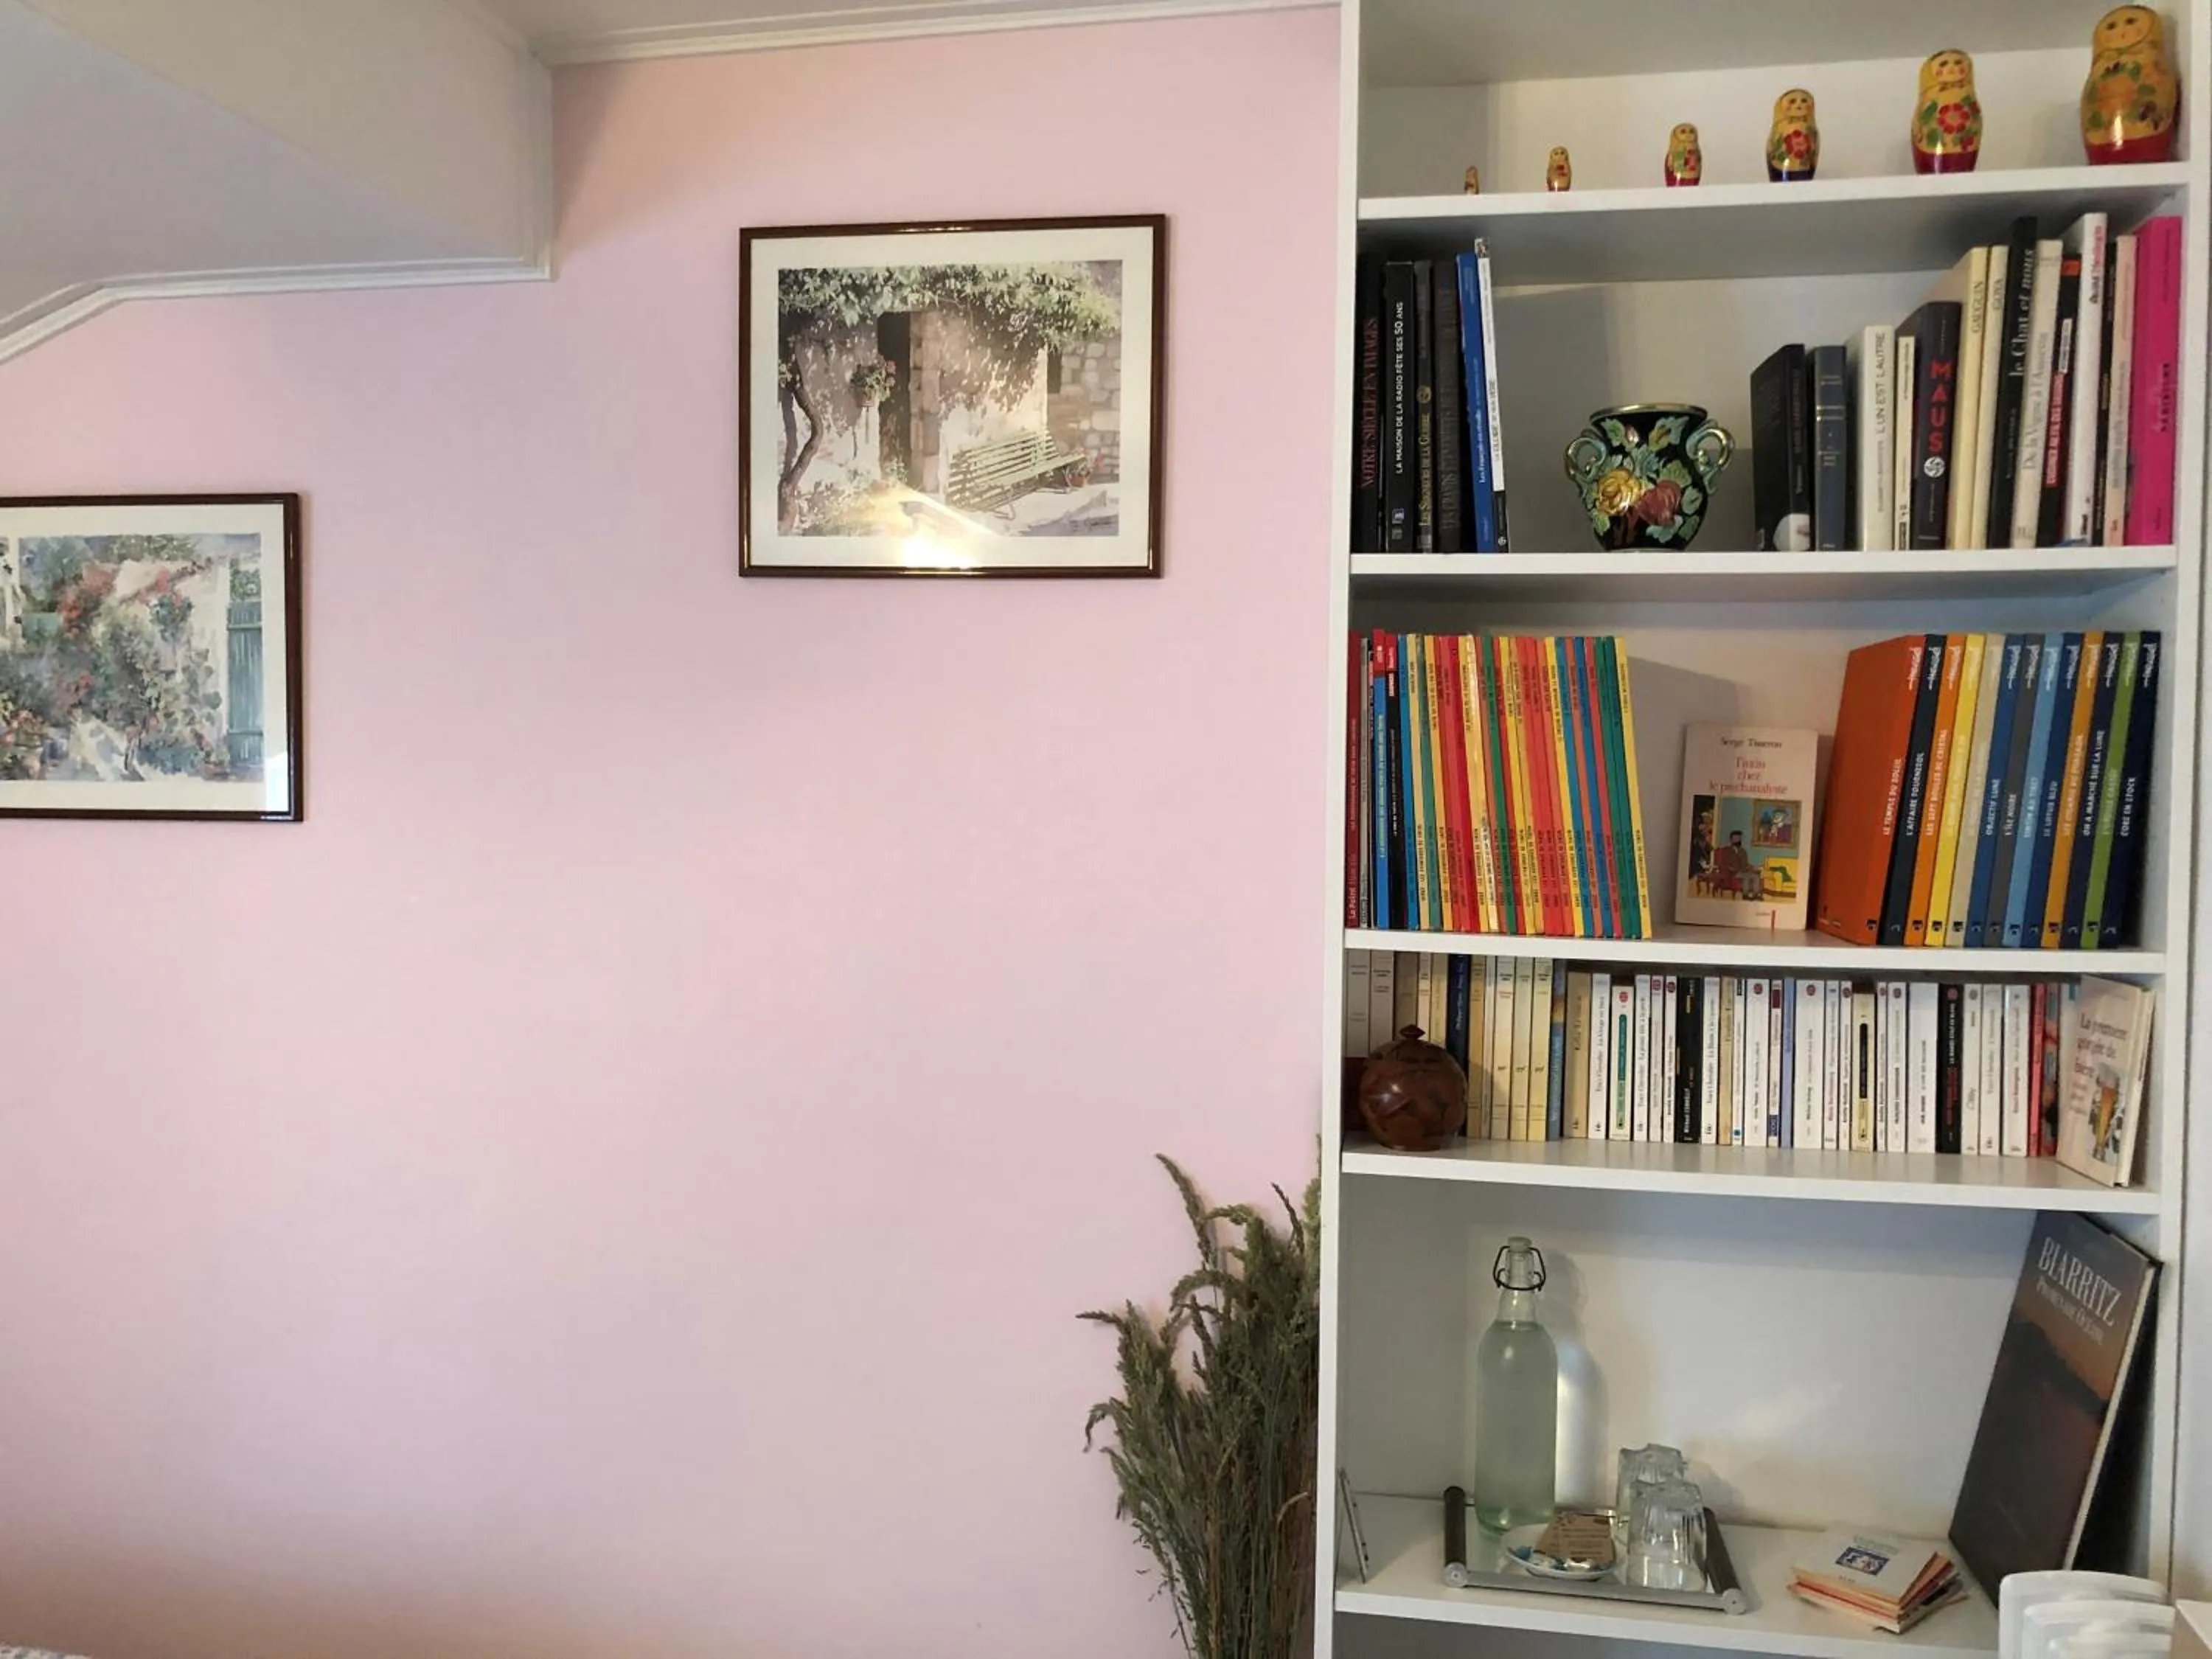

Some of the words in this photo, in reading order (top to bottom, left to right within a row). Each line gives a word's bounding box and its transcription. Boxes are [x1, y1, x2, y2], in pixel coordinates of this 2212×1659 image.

[2021, 248, 2035, 290] nous
[1992, 277, 2003, 311] GOYA
[2018, 294, 2030, 312] et
[1396, 301, 1404, 319] ANS
[1971, 280, 1983, 334] GAUGUIN
[1363, 317, 1379, 369] IMAGES
[1395, 336, 1403, 352] SES
[2010, 316, 2029, 357] Chat
[1393, 353, 1403, 373] FÊTE
[2007, 361, 2023, 377] le
[1363, 372, 1377, 390] EN
[1395, 375, 1403, 402] RADIO
[1876, 383, 1885, 405] EST
[1395, 402, 1403, 414] LA
[1928, 361, 1952, 453] MAUS
[1395, 414, 1403, 427] DE
[1361, 445, 1377, 488] NOTRE
[1396, 462, 1403, 474] LA
[2095, 729, 2105, 750] LUNE
[1735, 757, 1767, 770] Tintin
[2093, 752, 2101, 762] LA
[1736, 770, 1761, 782] chez
[1890, 758, 1902, 783] SOLEIL
[1911, 753, 1924, 798] TOURNESOL
[2090, 764, 2100, 780] SUR
[1709, 780, 1719, 790] le
[1888, 785, 1897, 796] DU
[2048, 780, 2058, 800] BLEU
[2124, 776, 2136, 802] STOCK
[1985, 801, 1997, 836] OBJECTIF
[1991, 779, 2000, 799] LUNE
[2007, 793, 2017, 818] NOIRE
[2085, 781, 2098, 815] MARCHÉ
[1884, 797, 1896, 826] TEMPLE
[1906, 799, 1917, 836] L'AFFAIRE
[2045, 801, 2055, 827] LOTUS
[2123, 804, 2132, 815] EN
[1882, 825, 1891, 836] LE
[2083, 823, 2091, 836] ON
[2121, 815, 2130, 837] COKE
[1349, 887, 1357, 909] Point
[1349, 909, 1357, 919] Le
[2037, 1236, 2122, 1328] BIARRITZ
